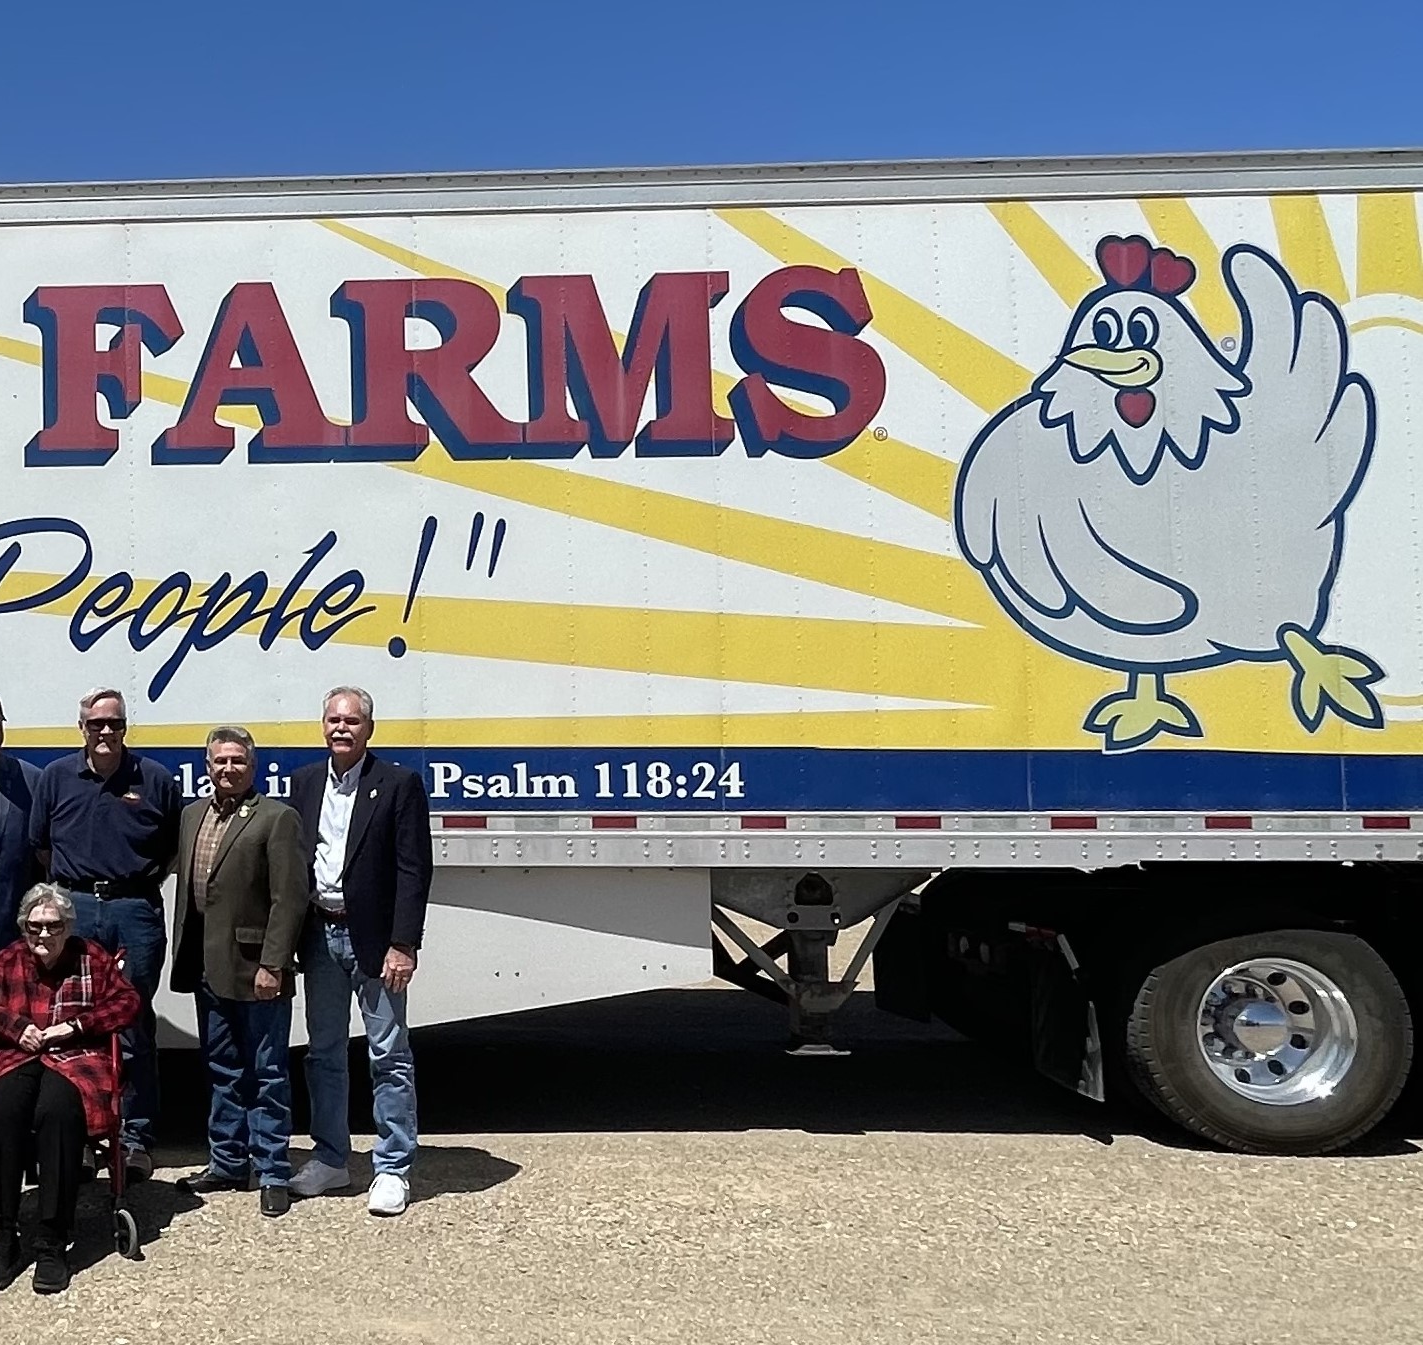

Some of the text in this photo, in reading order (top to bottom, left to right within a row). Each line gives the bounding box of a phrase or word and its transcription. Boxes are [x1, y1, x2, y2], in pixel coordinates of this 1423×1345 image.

[23, 265, 887, 468] FARMS
[429, 762, 579, 799] Psalm
[594, 761, 745, 800] 118:24
